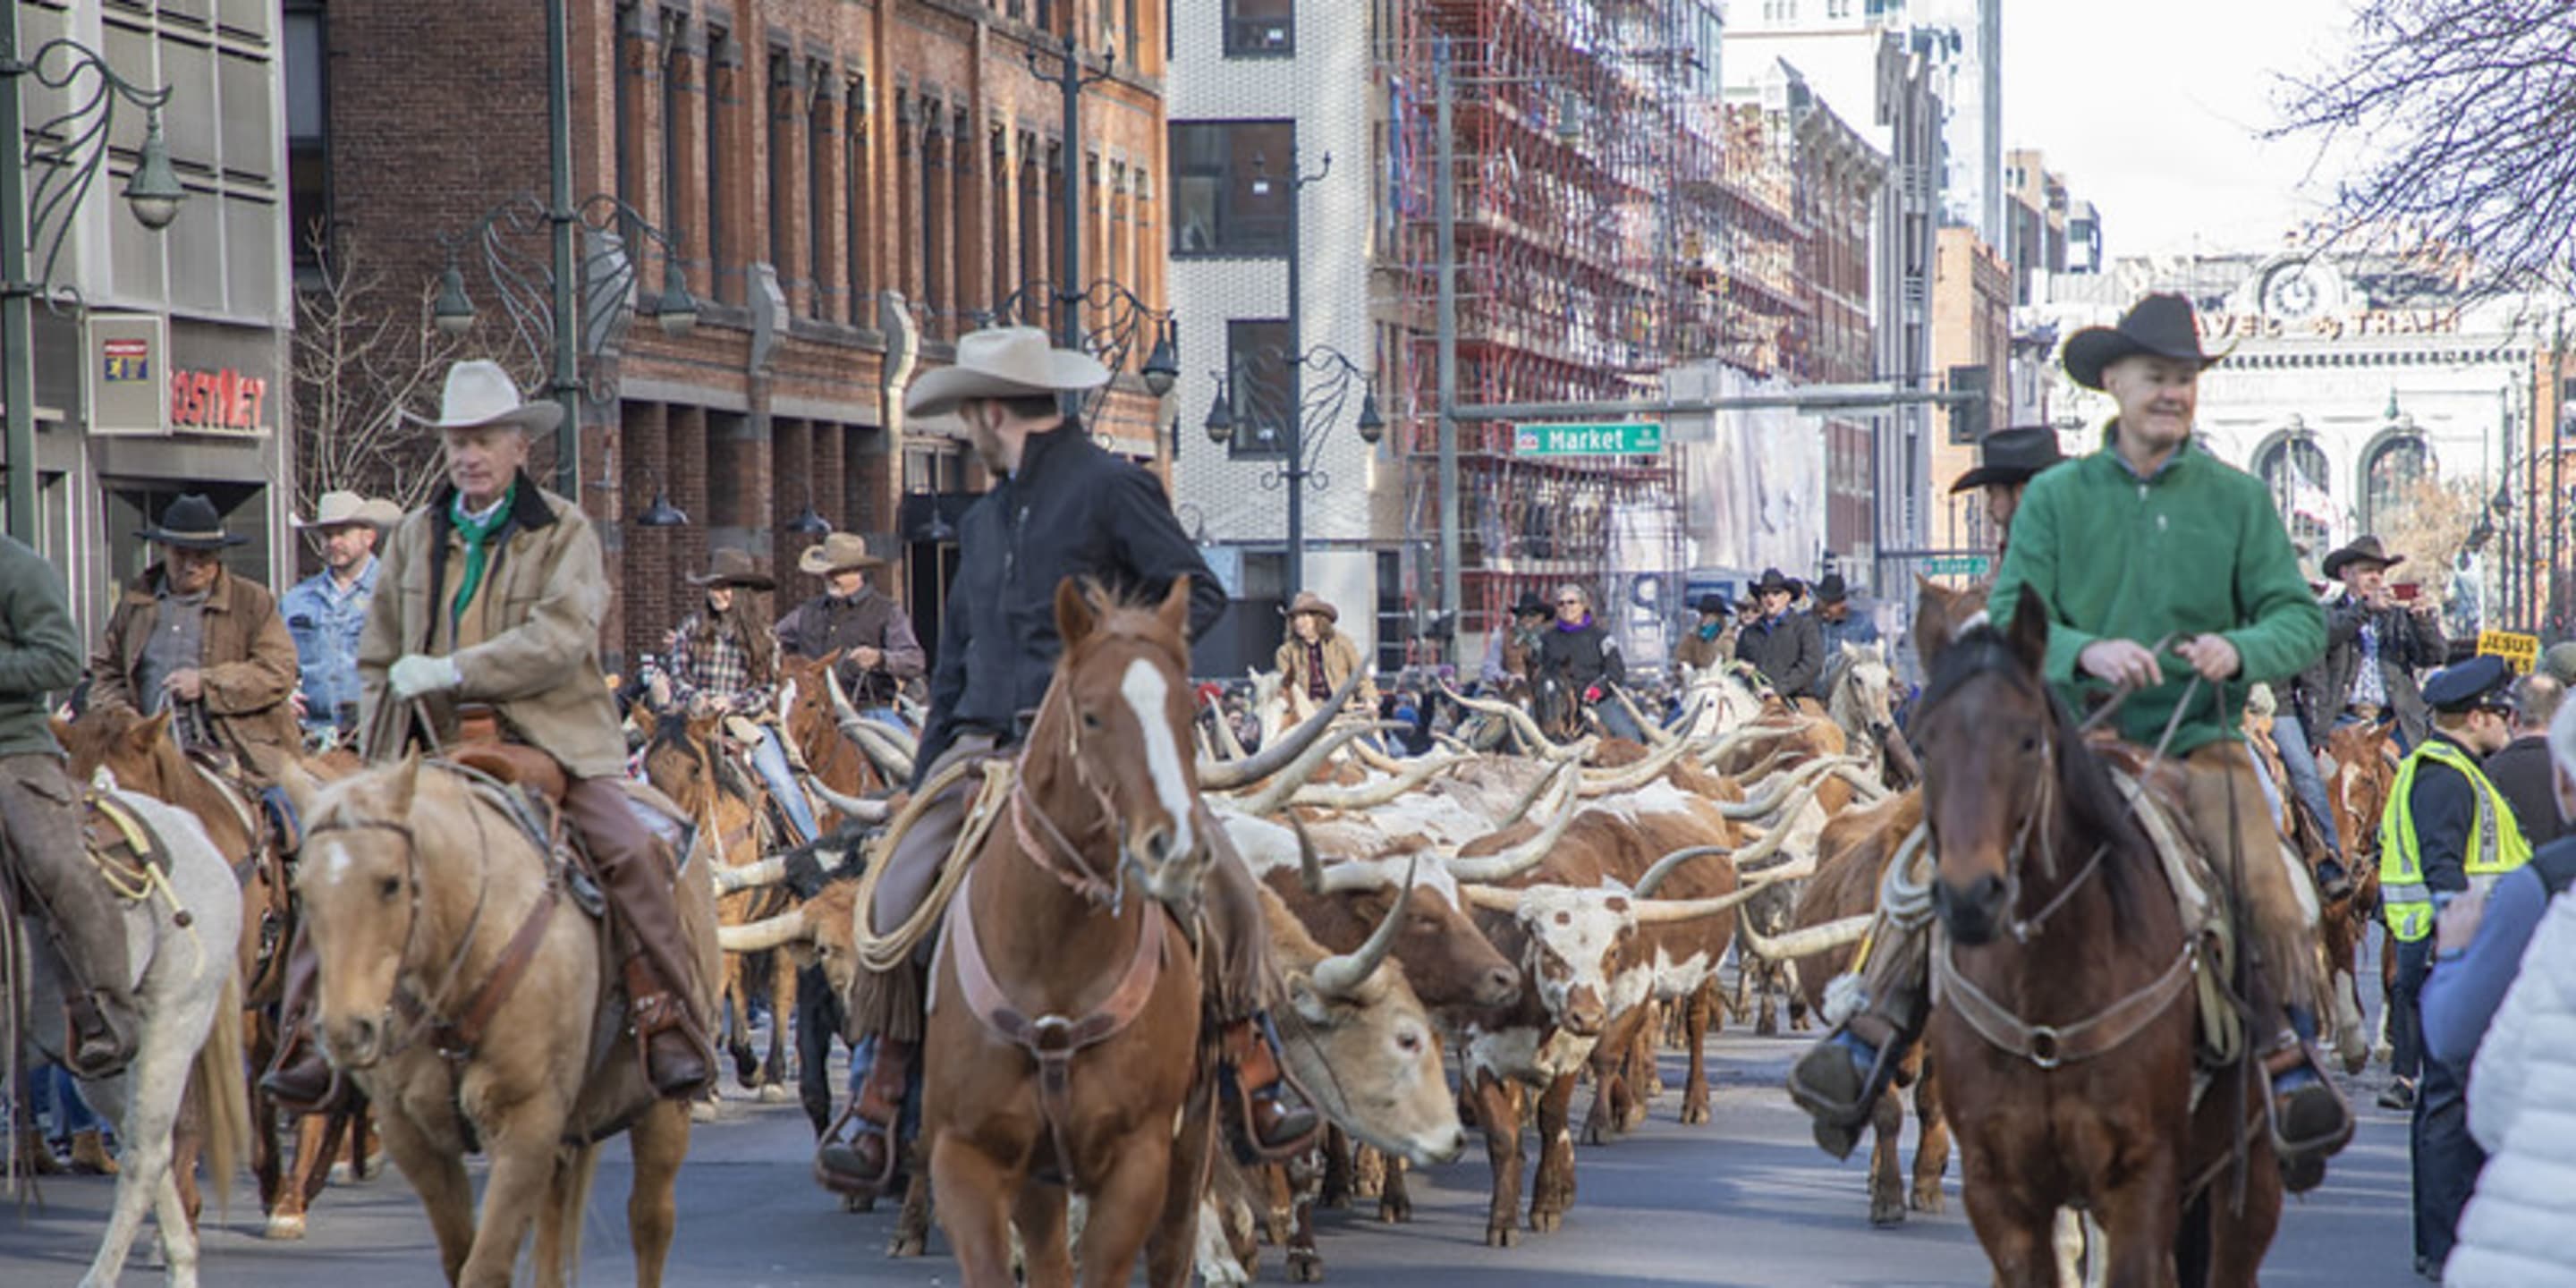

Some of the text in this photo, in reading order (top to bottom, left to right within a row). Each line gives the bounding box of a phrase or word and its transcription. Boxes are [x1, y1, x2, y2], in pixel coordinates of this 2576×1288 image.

[171, 368, 266, 428] OSTNET
[1549, 428, 1623, 450] Market
[2482, 634, 2535, 654] JESUS
